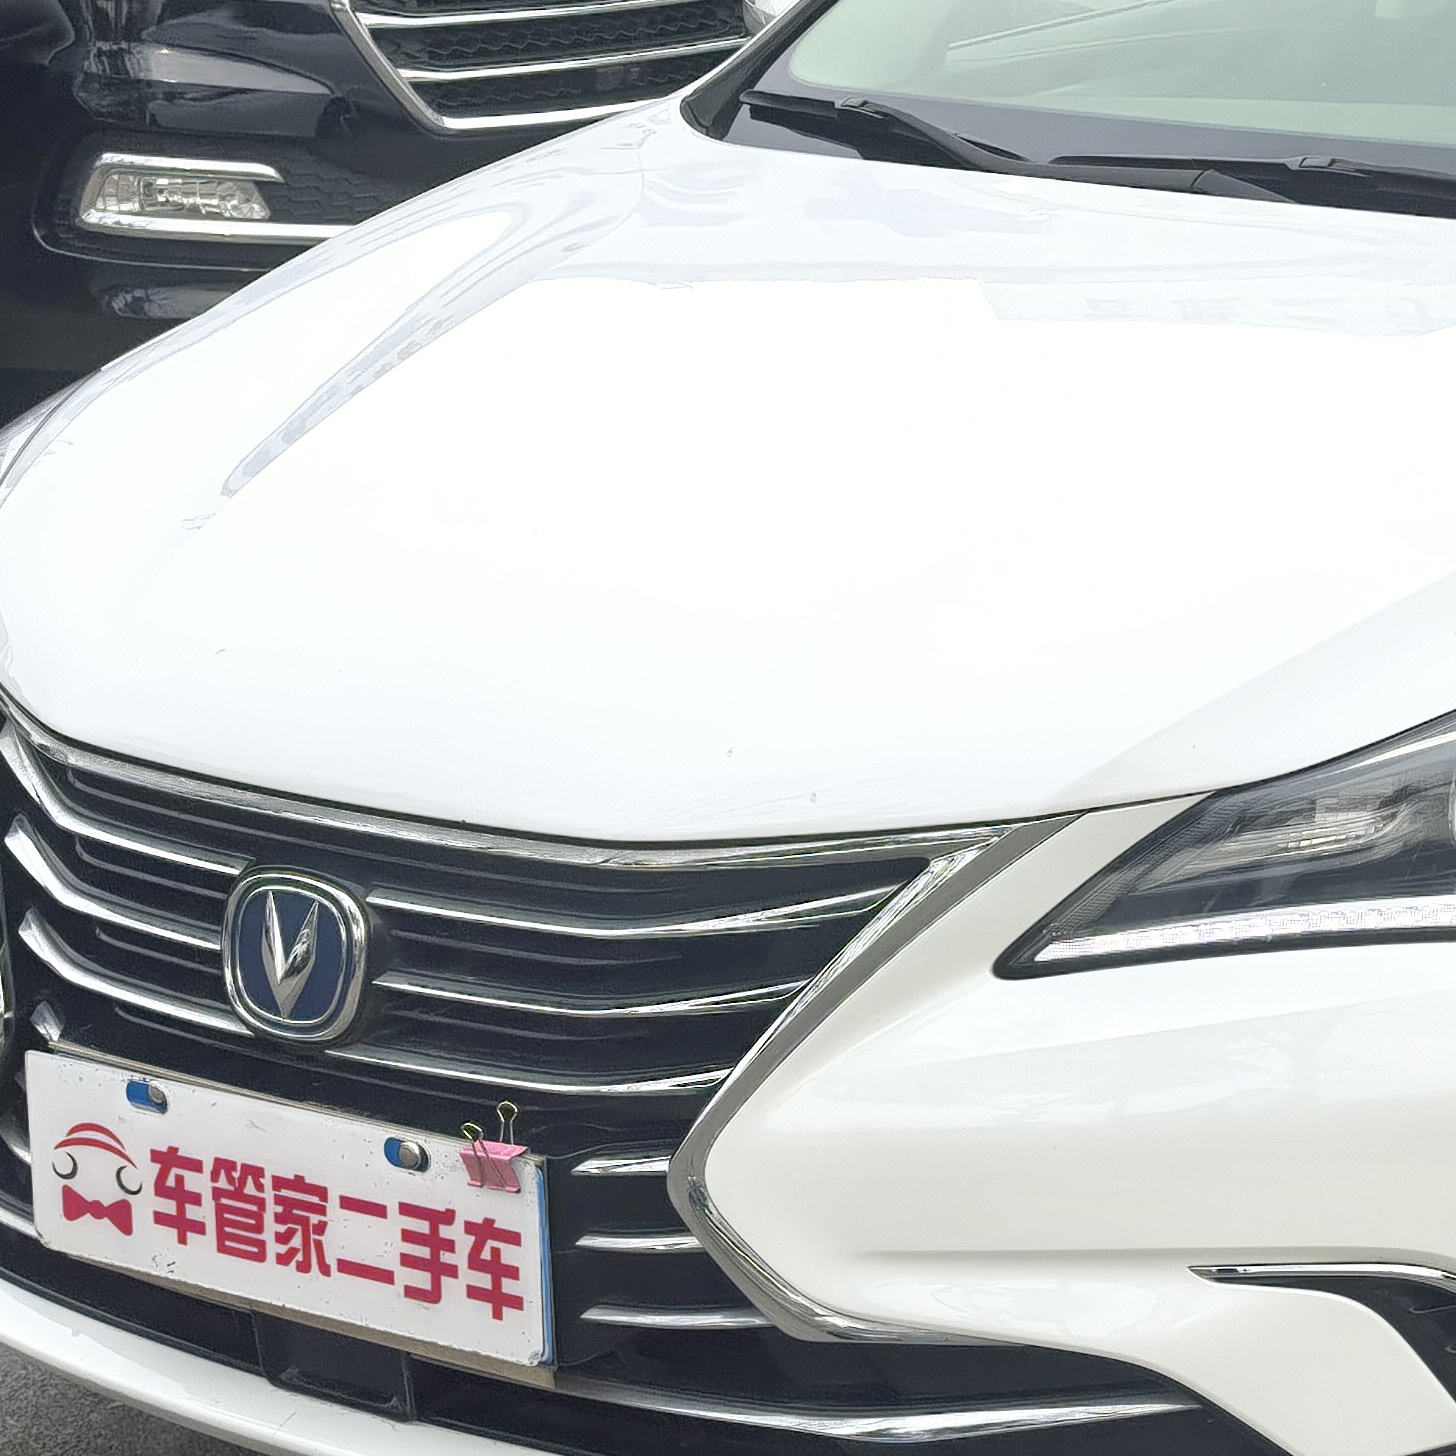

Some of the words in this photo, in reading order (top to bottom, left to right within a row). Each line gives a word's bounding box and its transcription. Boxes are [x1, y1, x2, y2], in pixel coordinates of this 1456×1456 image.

[149, 1145, 524, 1321] 车管家二手车
